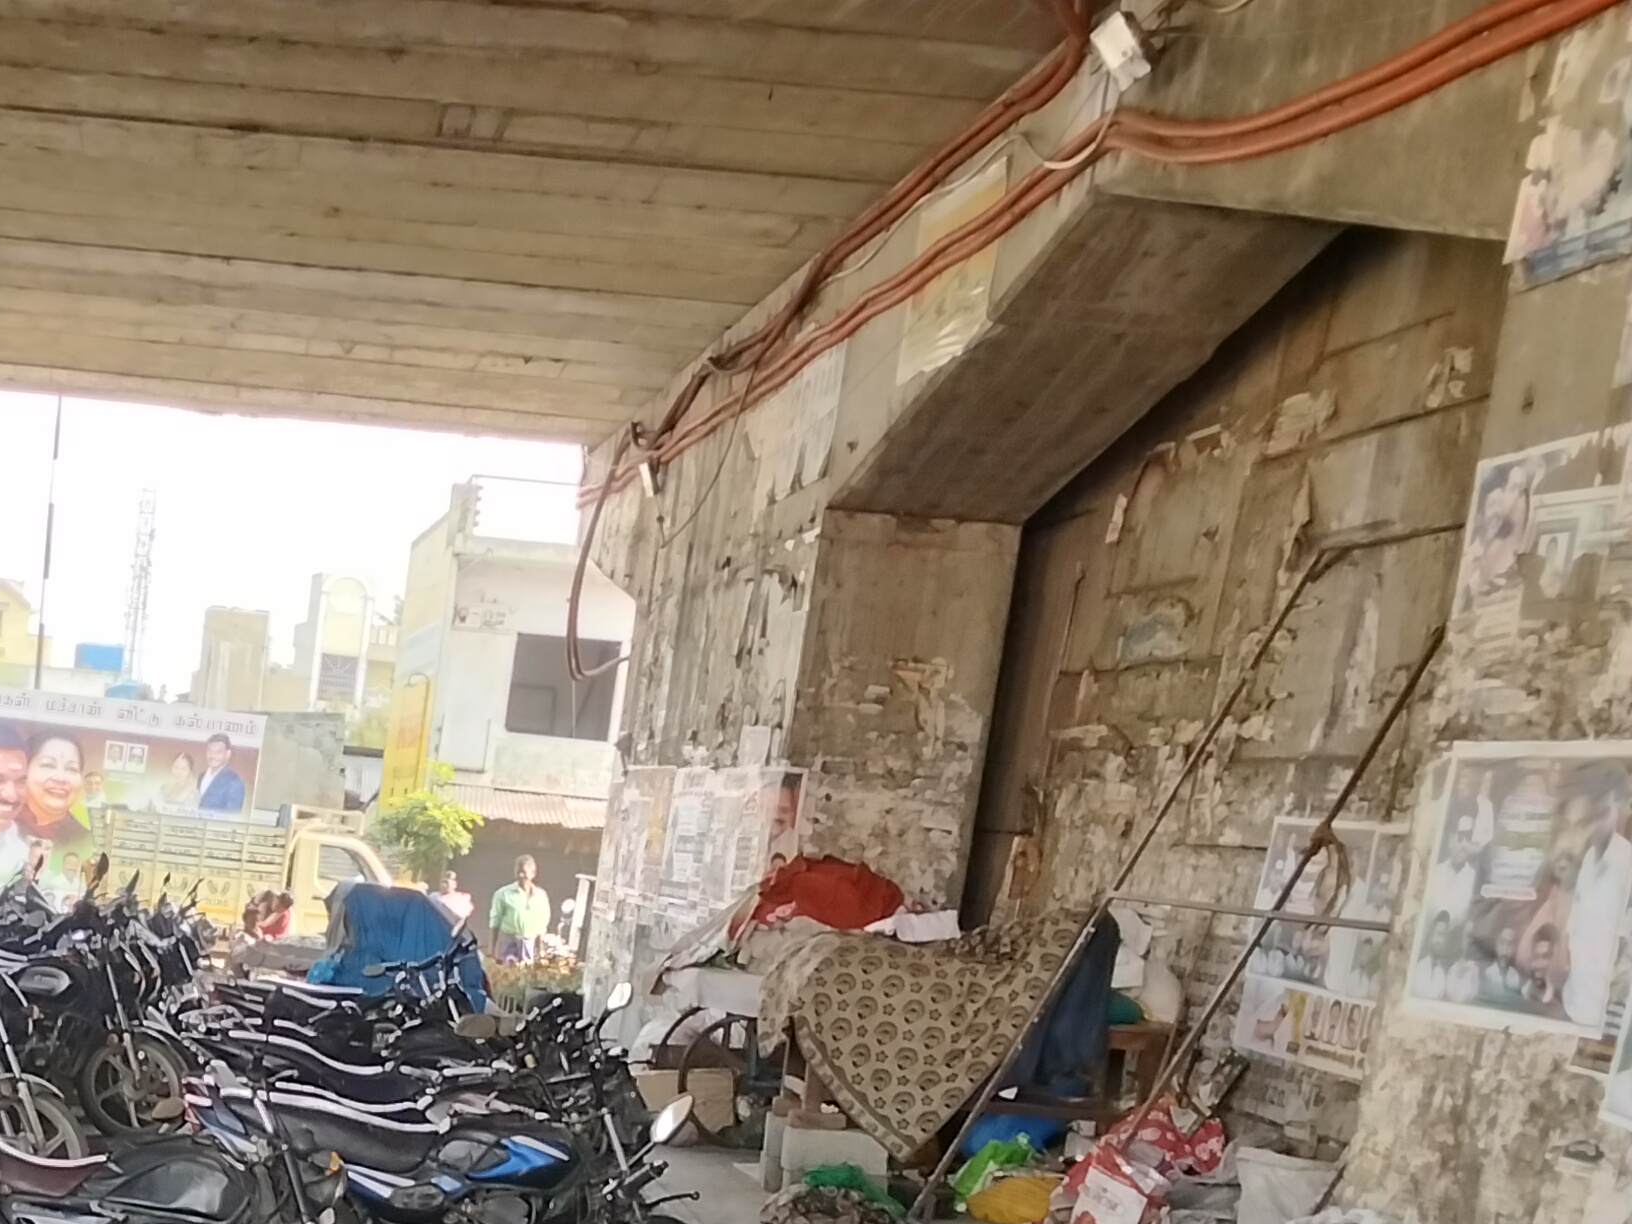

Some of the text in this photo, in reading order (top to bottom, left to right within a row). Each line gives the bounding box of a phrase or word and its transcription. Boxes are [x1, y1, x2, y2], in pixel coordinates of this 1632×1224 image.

[45, 697, 103, 716] மச்சான்
[117, 705, 161, 727] வீட்டு
[173, 712, 257, 735] கல்யாணம்
